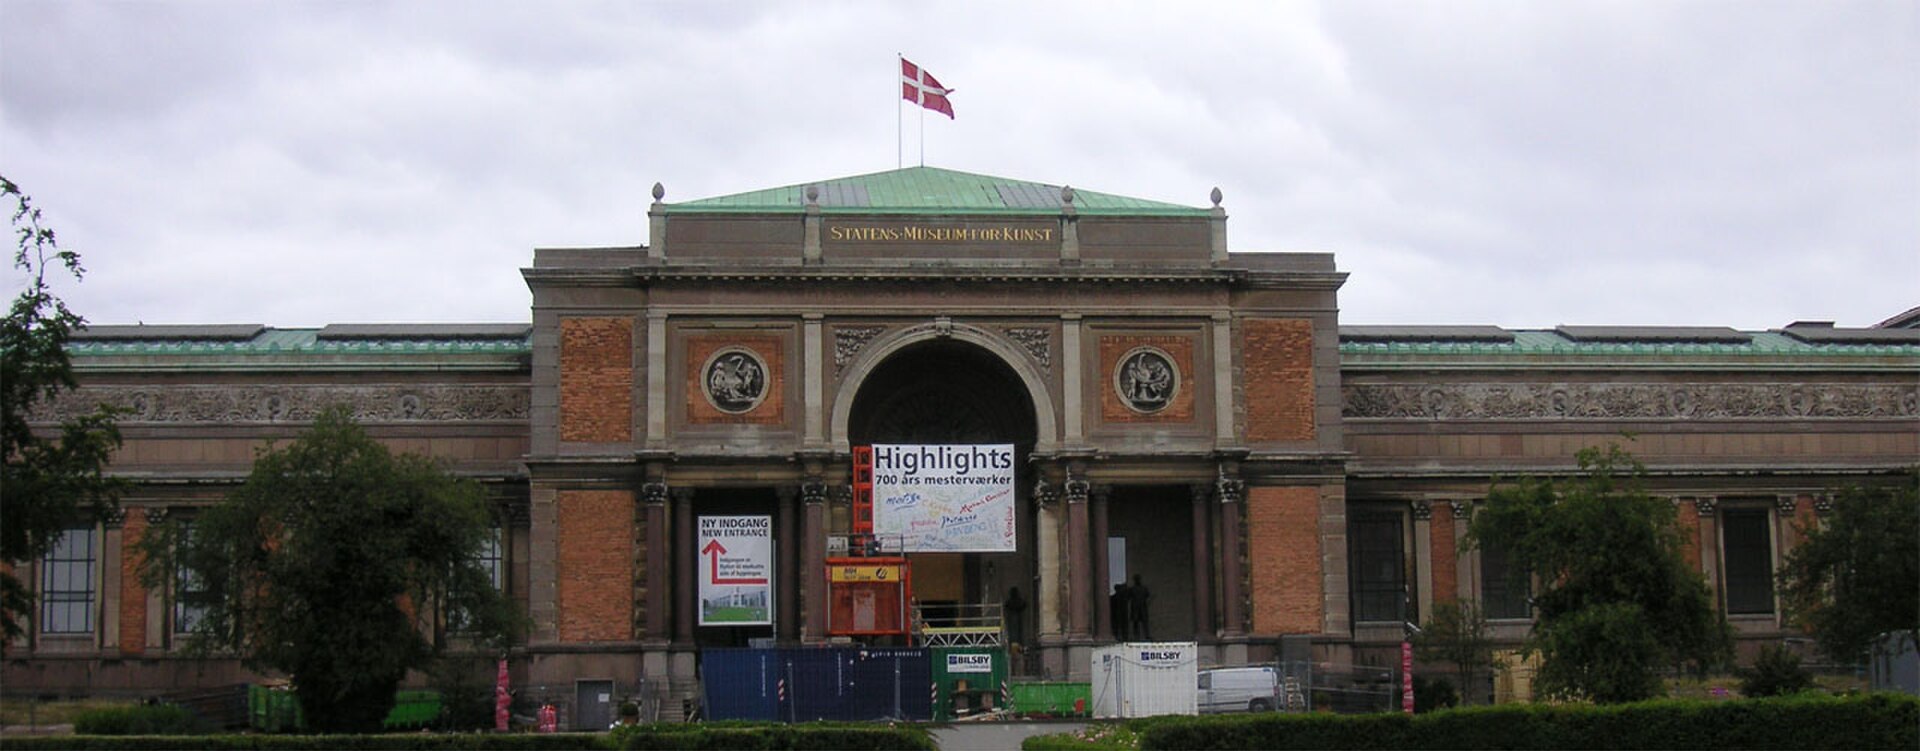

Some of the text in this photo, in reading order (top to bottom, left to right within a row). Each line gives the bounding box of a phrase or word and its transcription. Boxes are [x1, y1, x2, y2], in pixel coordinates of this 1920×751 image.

[1003, 226, 1053, 241] KUNST
[875, 446, 1012, 475] Highlights
[876, 474, 1012, 485] 700 års mesterværker
[702, 518, 768, 528] NY INDGANG
[702, 529, 768, 537] NEW ENTRANCE
[958, 655, 990, 664] BILSBY
[1150, 652, 1181, 660] BILSBY
